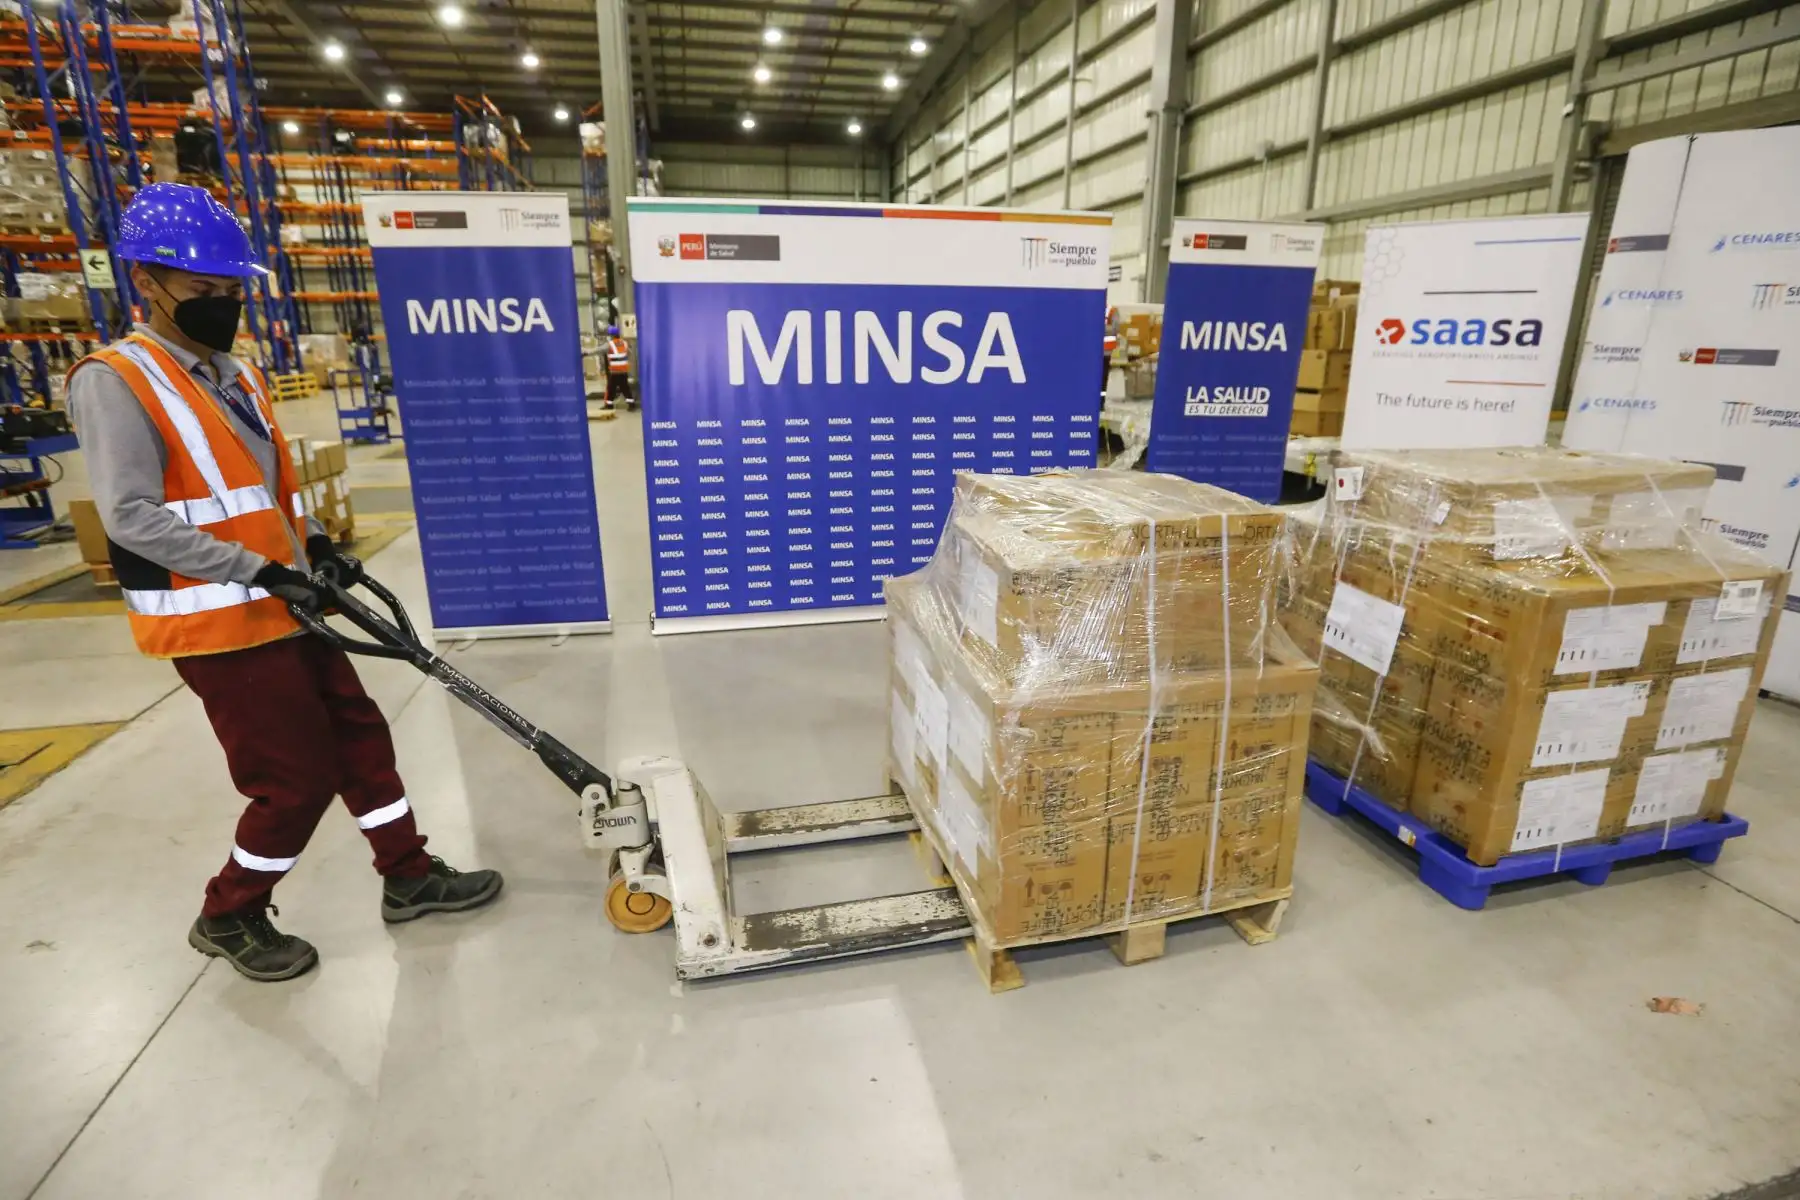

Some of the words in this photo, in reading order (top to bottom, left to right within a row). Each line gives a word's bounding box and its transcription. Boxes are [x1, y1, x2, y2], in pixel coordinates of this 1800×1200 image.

[1049, 242, 1097, 257] Siempre
[1065, 257, 1097, 267] pueblo
[1618, 290, 1684, 300] CENARES
[405, 297, 555, 334] MINSA
[1180, 320, 1288, 352] MINSA
[1411, 318, 1543, 347] saasa
[726, 309, 1027, 386] MINSA
[1593, 344, 1642, 355] Siempre
[1186, 386, 1209, 403] LA
[1213, 386, 1270, 403] SALUD
[1376, 392, 1402, 406] The
[1406, 393, 1453, 410] future
[1456, 398, 1469, 411] is
[1473, 399, 1515, 413] here!
[1593, 398, 1657, 410] CENARES
[1188, 405, 1200, 414] ES
[1203, 405, 1216, 414] TU
[1219, 405, 1264, 414] DERECHO
[1752, 406, 1800, 419] Siempr
[651, 420, 677, 430] MINSA
[697, 420, 722, 428] MINSA
[741, 418, 766, 427] MINSA
[785, 418, 810, 426] MINSA
[828, 417, 852, 425] MINSA
[870, 416, 894, 424] MINSA
[912, 415, 936, 424] MINSA
[953, 415, 976, 423] MINSA
[1071, 414, 1092, 422] MINSA
[652, 439, 678, 447] MINSA
[697, 437, 723, 446] MINSA
[742, 436, 767, 444] MINSA
[785, 435, 810, 443] MINSA
[828, 434, 852, 442] MINSA
[870, 433, 894, 441] MINSA
[912, 432, 935, 440] MINSA
[953, 432, 975, 440] MINSA
[992, 431, 1015, 439] MINSA
[1032, 431, 1053, 439] MINSA
[654, 459, 679, 467] MINSA
[699, 457, 724, 466] MINSA
[743, 456, 767, 464] MINSA
[786, 455, 810, 463] MINSA
[829, 453, 853, 461] MINSA
[871, 452, 894, 460] MINSA
[912, 451, 935, 459] MINSA
[992, 449, 1014, 457] MINSA
[1031, 449, 1052, 457] MINSA
[1069, 448, 1090, 456] MINSA
[655, 476, 680, 485] MINSA
[700, 475, 725, 483] MINSA
[744, 473, 768, 481] MINSA
[787, 472, 811, 480] MINSA
[829, 470, 853, 479] MINSA
[871, 469, 895, 477] MINSA
[912, 468, 935, 476] MINSA
[656, 496, 682, 504] MINSA
[701, 494, 725, 502] MINSA
[744, 492, 769, 501] MINSA
[787, 491, 811, 499] MINSA
[830, 489, 853, 497] MINSA
[871, 488, 894, 496] MINSA
[912, 487, 935, 495] MINSA
[657, 513, 683, 522] MINSA
[701, 511, 726, 520] MINSA
[745, 509, 769, 518] MINSA
[788, 508, 812, 516] MINSA
[830, 506, 853, 514] MINSA
[871, 504, 894, 512] MINSA
[912, 503, 935, 511] MINSA
[659, 532, 684, 541] MINSA
[703, 530, 727, 539] MINSA
[746, 528, 770, 536] MINSA
[788, 527, 812, 535] MINSA
[830, 524, 854, 533] MINSA
[871, 523, 894, 531] MINSA
[912, 521, 934, 529] MINSA
[1720, 523, 1770, 542] Siempre
[660, 549, 684, 558] MINSA
[704, 547, 728, 556] MINSA
[747, 545, 770, 554] MINSA
[789, 543, 813, 551] MINSA
[831, 541, 854, 549] MINSA
[872, 539, 894, 547] MINSA
[912, 537, 934, 545] MINSA
[661, 568, 686, 577] MINSA
[704, 566, 728, 575] MINSA
[747, 563, 771, 572] MINSA
[789, 560, 813, 570] MINSA
[831, 559, 854, 567] MINSA
[872, 557, 894, 565] MINSA
[662, 585, 687, 594] MINSA
[705, 583, 730, 591] MINSA
[748, 580, 772, 588] MINSA
[790, 578, 813, 586] MINSA
[831, 575, 854, 583] MINSA
[664, 604, 688, 612] MINSA
[706, 601, 731, 609] MINSA
[749, 598, 773, 607] MINSA
[790, 596, 814, 604] MINSA
[832, 593, 854, 601] MINSA
